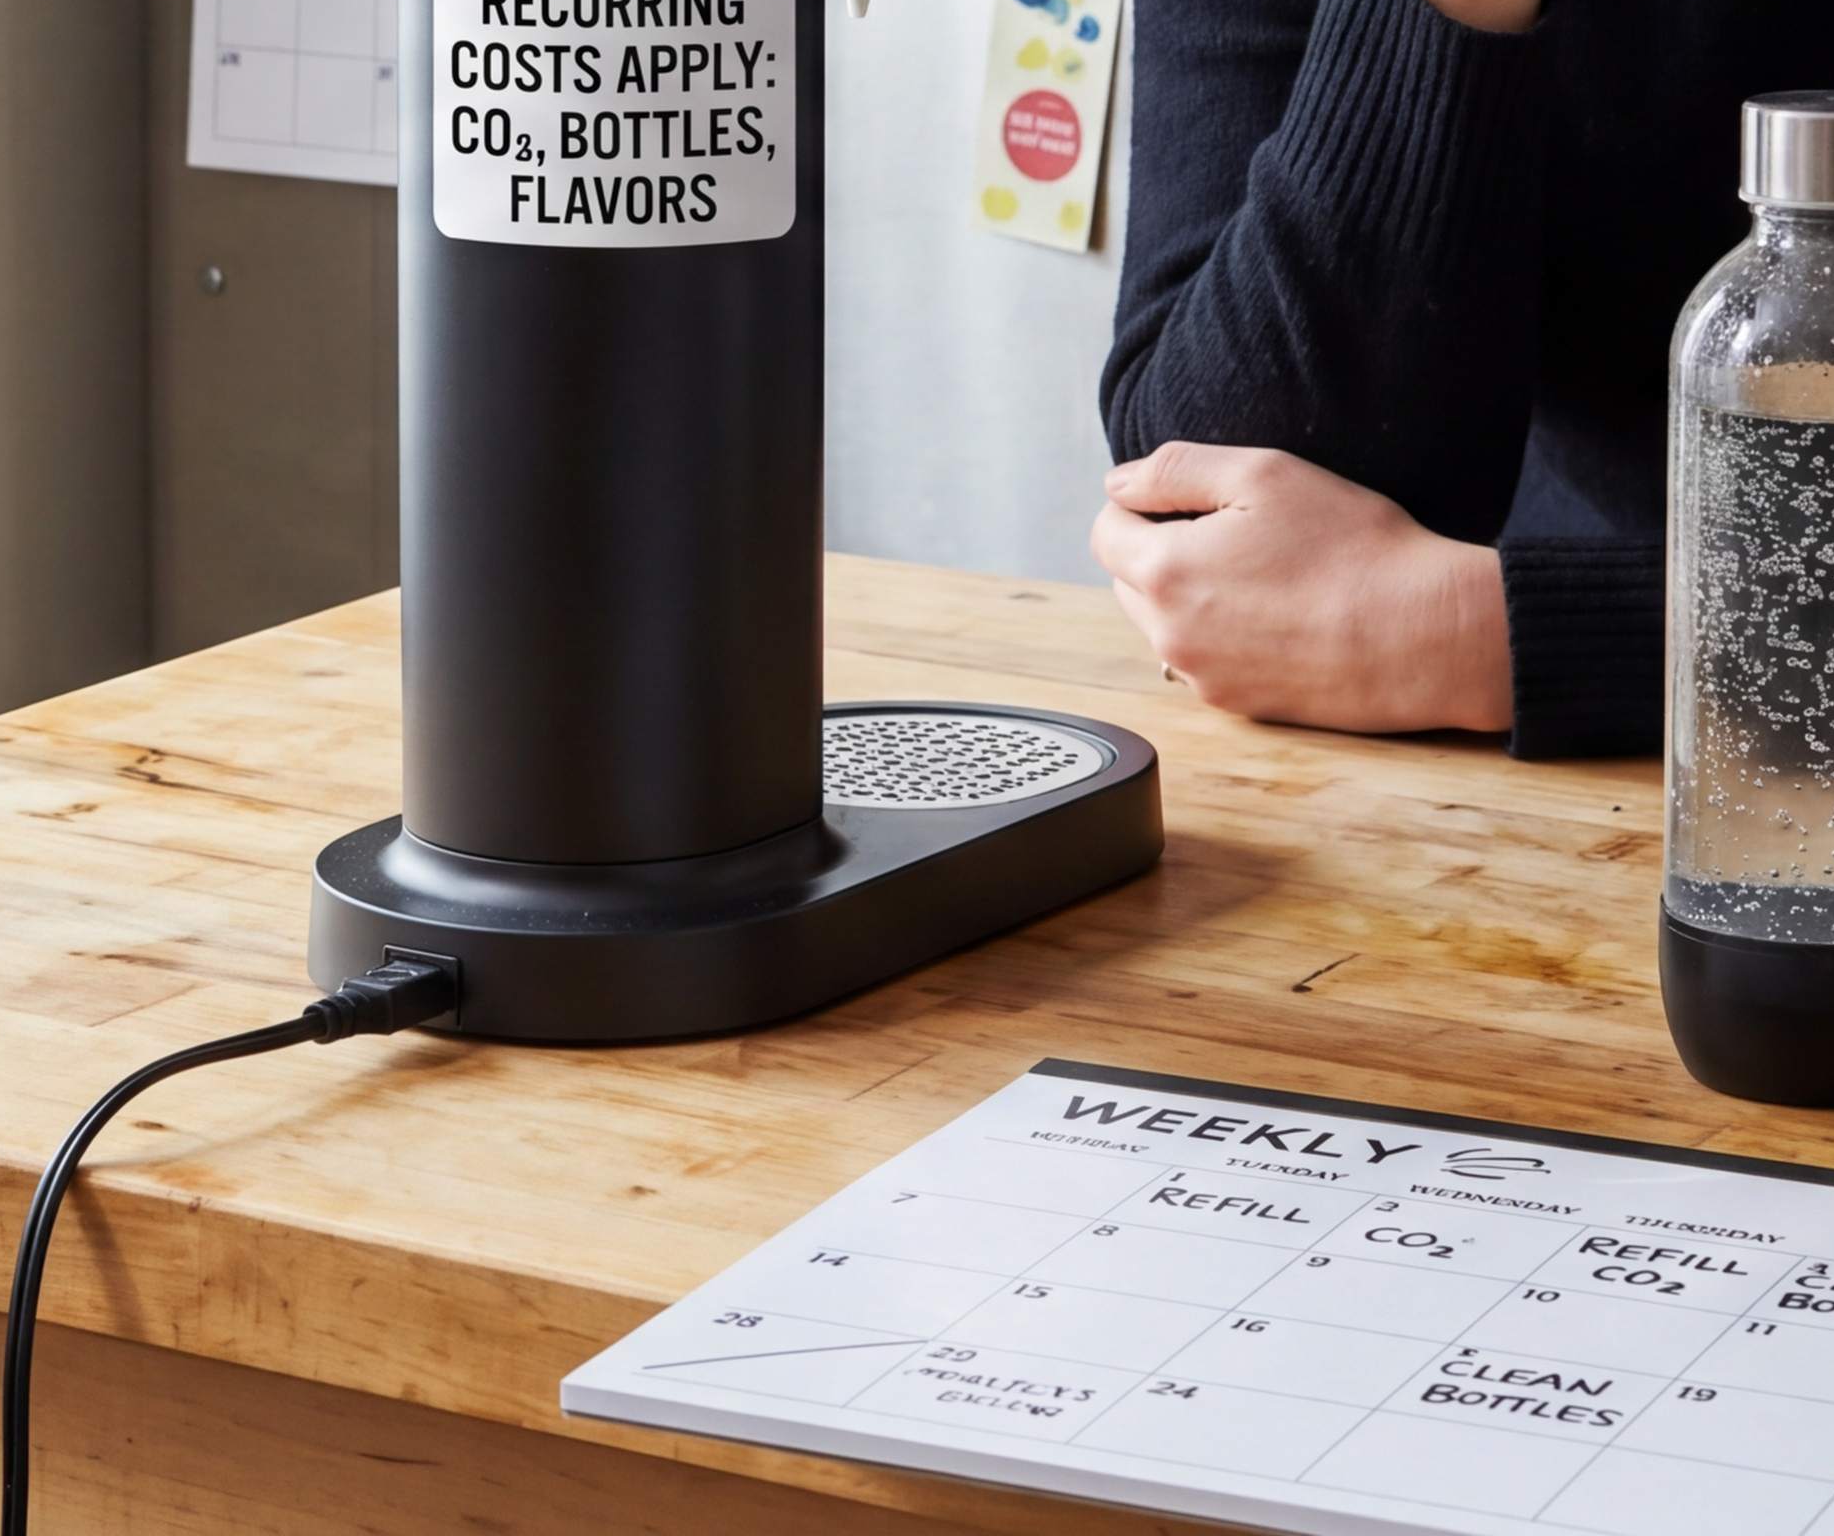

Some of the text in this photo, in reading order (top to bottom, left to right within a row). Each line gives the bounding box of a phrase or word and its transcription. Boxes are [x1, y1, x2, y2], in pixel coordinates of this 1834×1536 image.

[451, 39, 602, 94] COSTS
[616, 39, 776, 94] APPLY:
[560, 105, 776, 162] BOTTLES,
[510, 173, 717, 225] FLAVORS
[1062, 1095, 1423, 1165] WEEKLY
[1148, 1187, 1311, 1225] REFILL
[1092, 1224, 1120, 1237] 8
[1306, 1256, 1332, 1269] 9
[1577, 1236, 1750, 1277] REFILL
[1013, 1283, 1054, 1301] 15
[1521, 1288, 1562, 1303] 10
[1145, 1381, 1200, 1400] 24
[1439, 1360, 1614, 1398] CLEAN
[1676, 1385, 1719, 1404] 19
